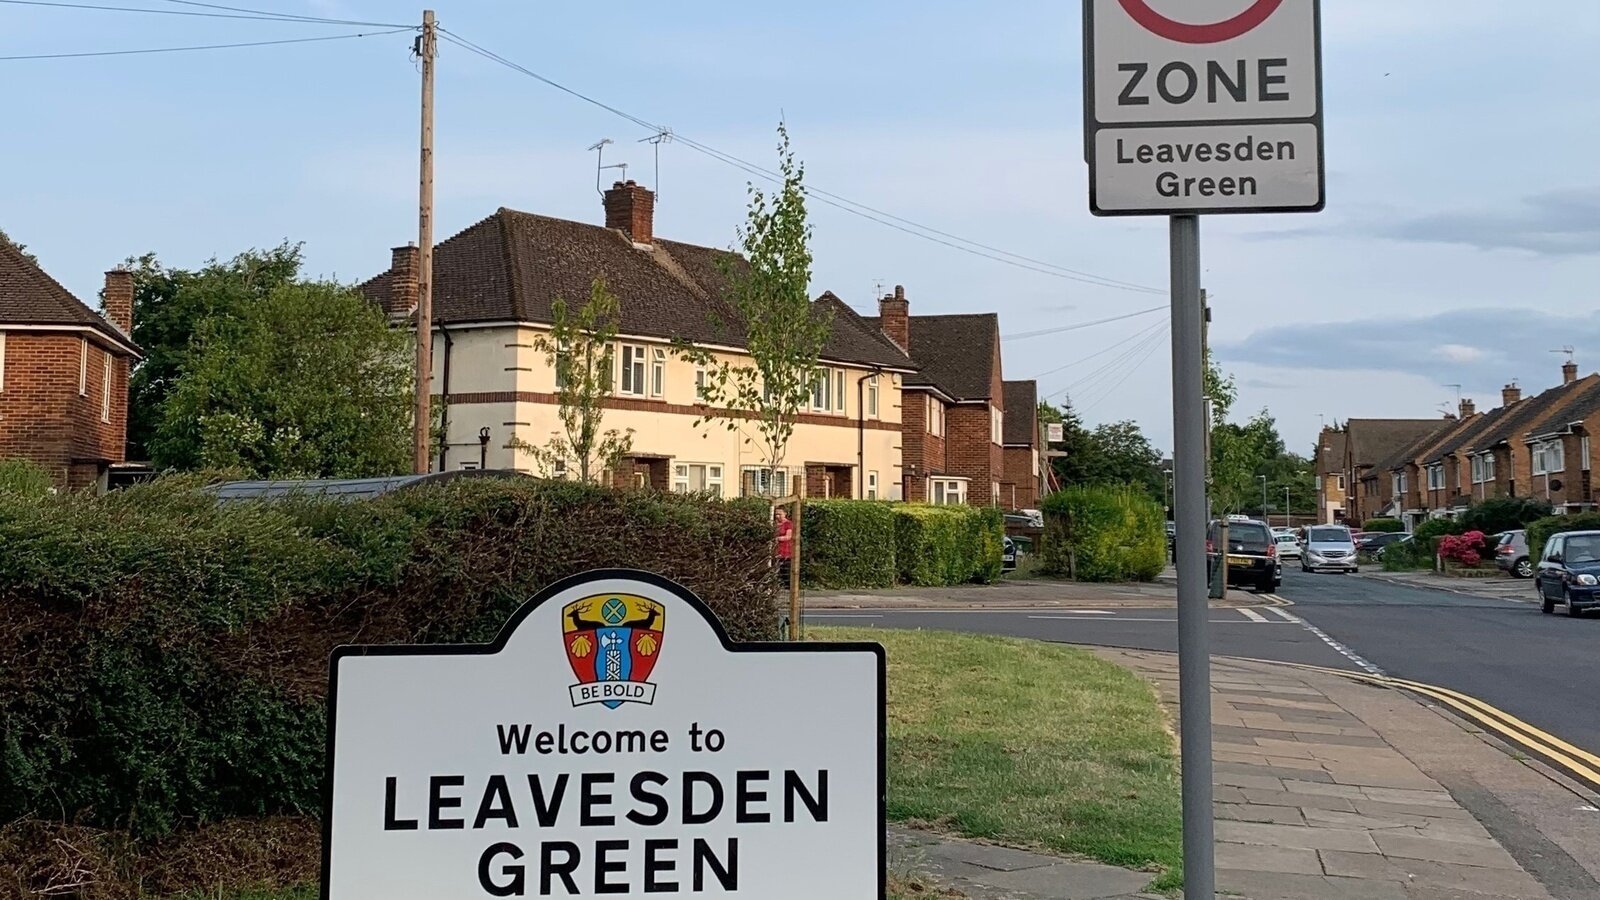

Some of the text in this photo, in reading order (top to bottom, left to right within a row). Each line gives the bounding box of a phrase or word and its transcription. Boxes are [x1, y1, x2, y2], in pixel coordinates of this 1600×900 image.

[1117, 57, 1290, 107] ZONE
[1117, 134, 1296, 165] Leavesden
[1155, 171, 1257, 198] Green
[581, 684, 645, 700] BE BOLD
[496, 721, 725, 755] Welcome to
[383, 769, 829, 831] LEAVESDEN
[477, 837, 740, 897] GREEN
